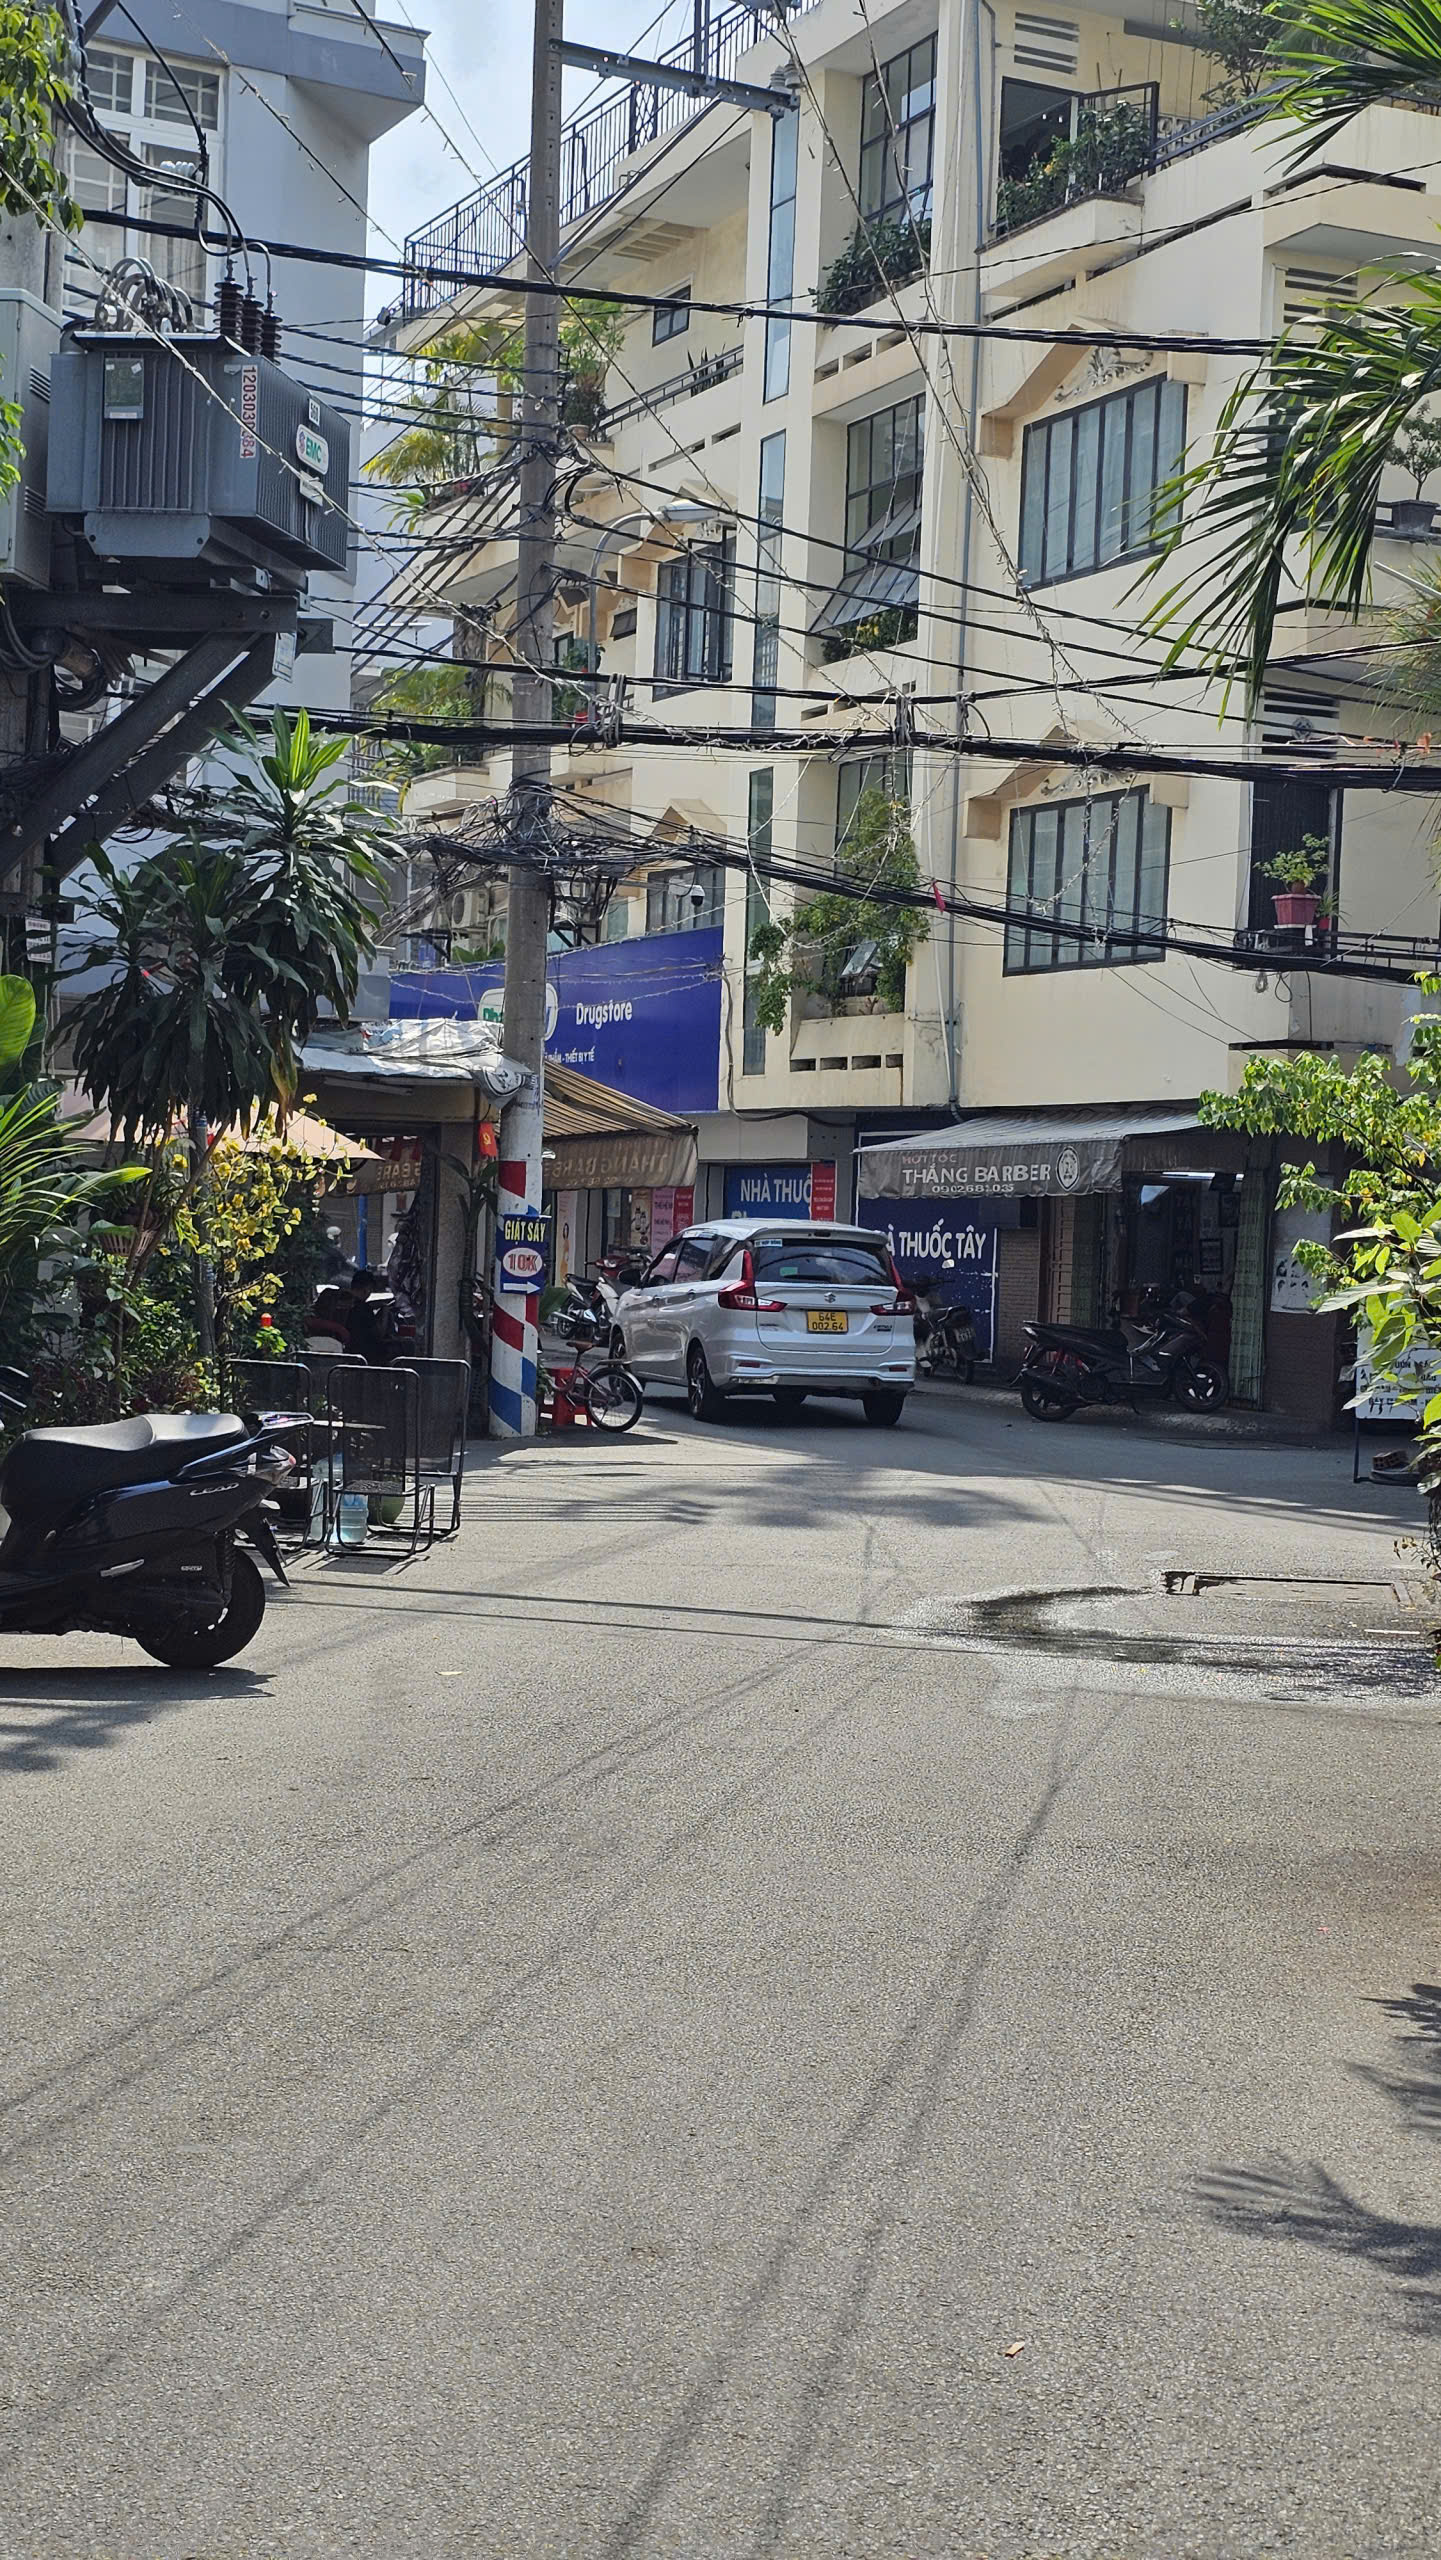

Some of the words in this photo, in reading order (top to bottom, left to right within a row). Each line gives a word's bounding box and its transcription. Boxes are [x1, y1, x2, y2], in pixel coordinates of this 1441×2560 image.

[576, 1000, 632, 1029] Drugstore
[902, 1163, 968, 1184] THẮNG
[974, 1164, 1051, 1183] BARBER
[740, 1172, 771, 1202] NHÀ
[505, 1217, 526, 1245] GIẶT
[899, 1218, 952, 1259] THUỐC
[955, 1225, 986, 1259] TÂY
[508, 1254, 538, 1271] 10K
[811, 1321, 844, 1331] 002.64
[818, 1312, 836, 1321] 64E
